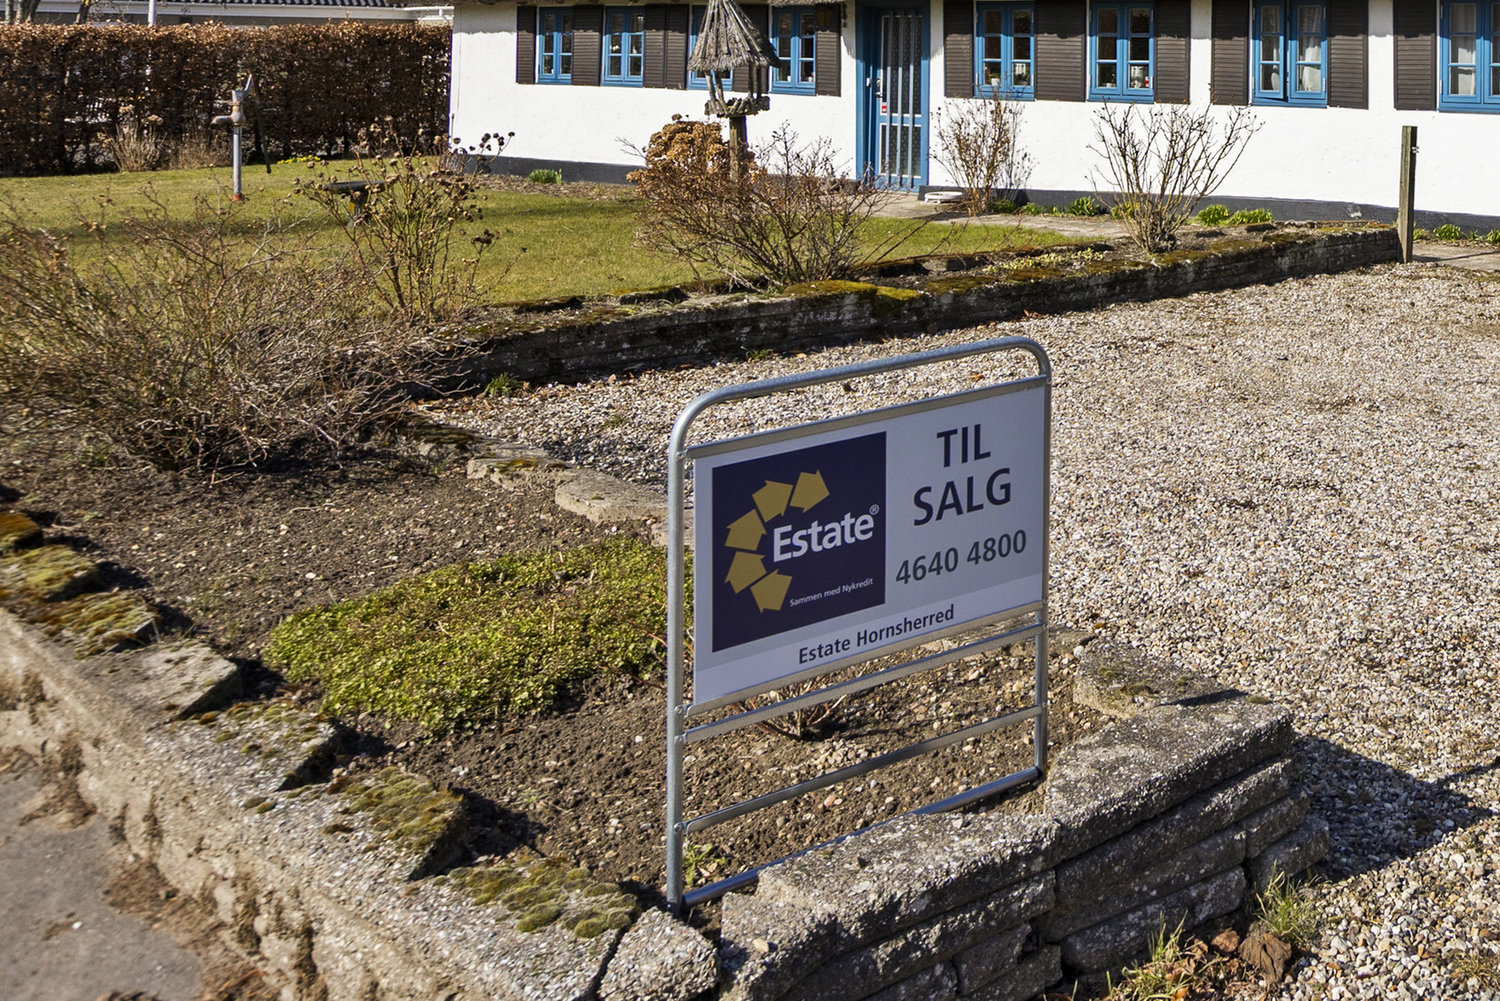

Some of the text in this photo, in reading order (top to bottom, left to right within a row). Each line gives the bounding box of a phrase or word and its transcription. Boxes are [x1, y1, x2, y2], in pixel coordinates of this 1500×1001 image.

[936, 423, 991, 468] TIL
[913, 467, 1011, 526] SALG
[895, 529, 1027, 585] 4640 4800
[789, 578, 874, 607] Sammen med Nykredit
[799, 603, 954, 664] Estate Hornsherred
